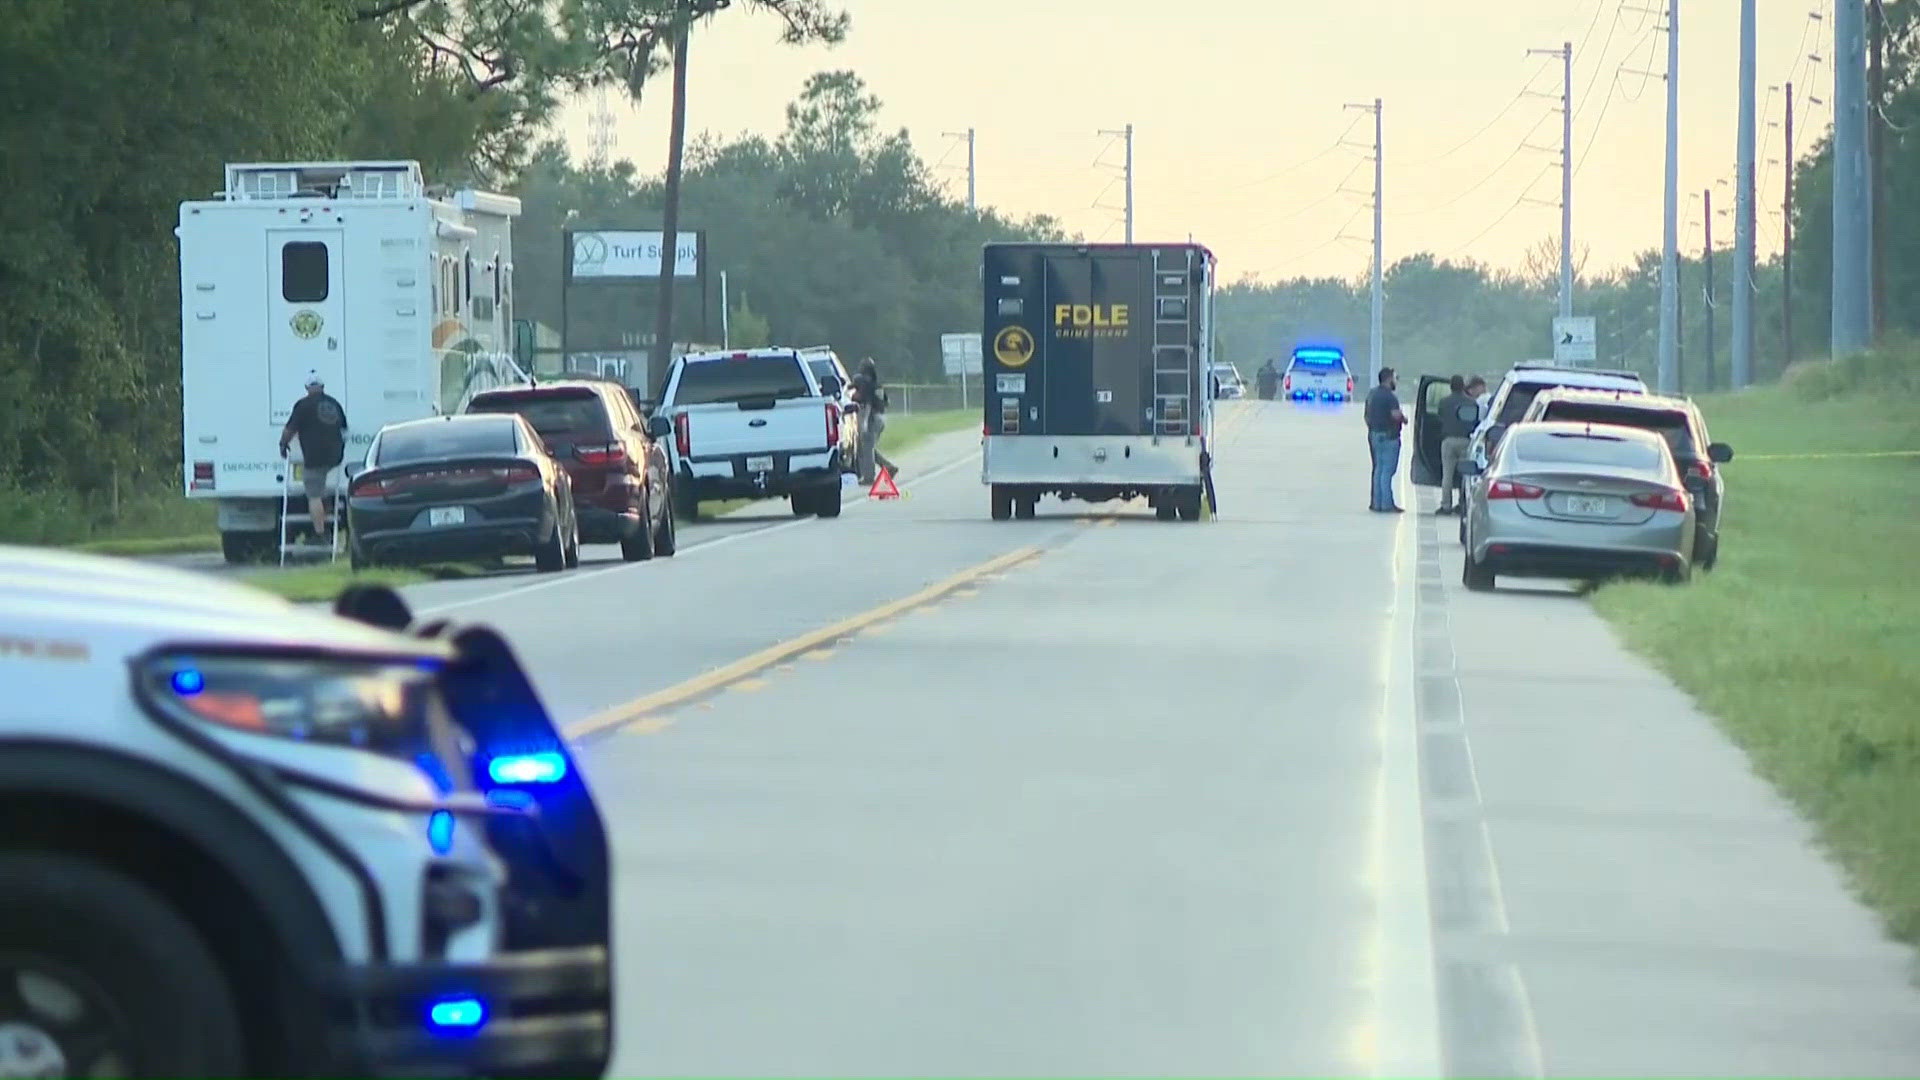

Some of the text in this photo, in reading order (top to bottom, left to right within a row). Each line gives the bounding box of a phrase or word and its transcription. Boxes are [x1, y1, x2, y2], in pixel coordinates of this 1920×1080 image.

[613, 244, 698, 262] Turf Suply
[1055, 304, 1129, 326] FDLE
